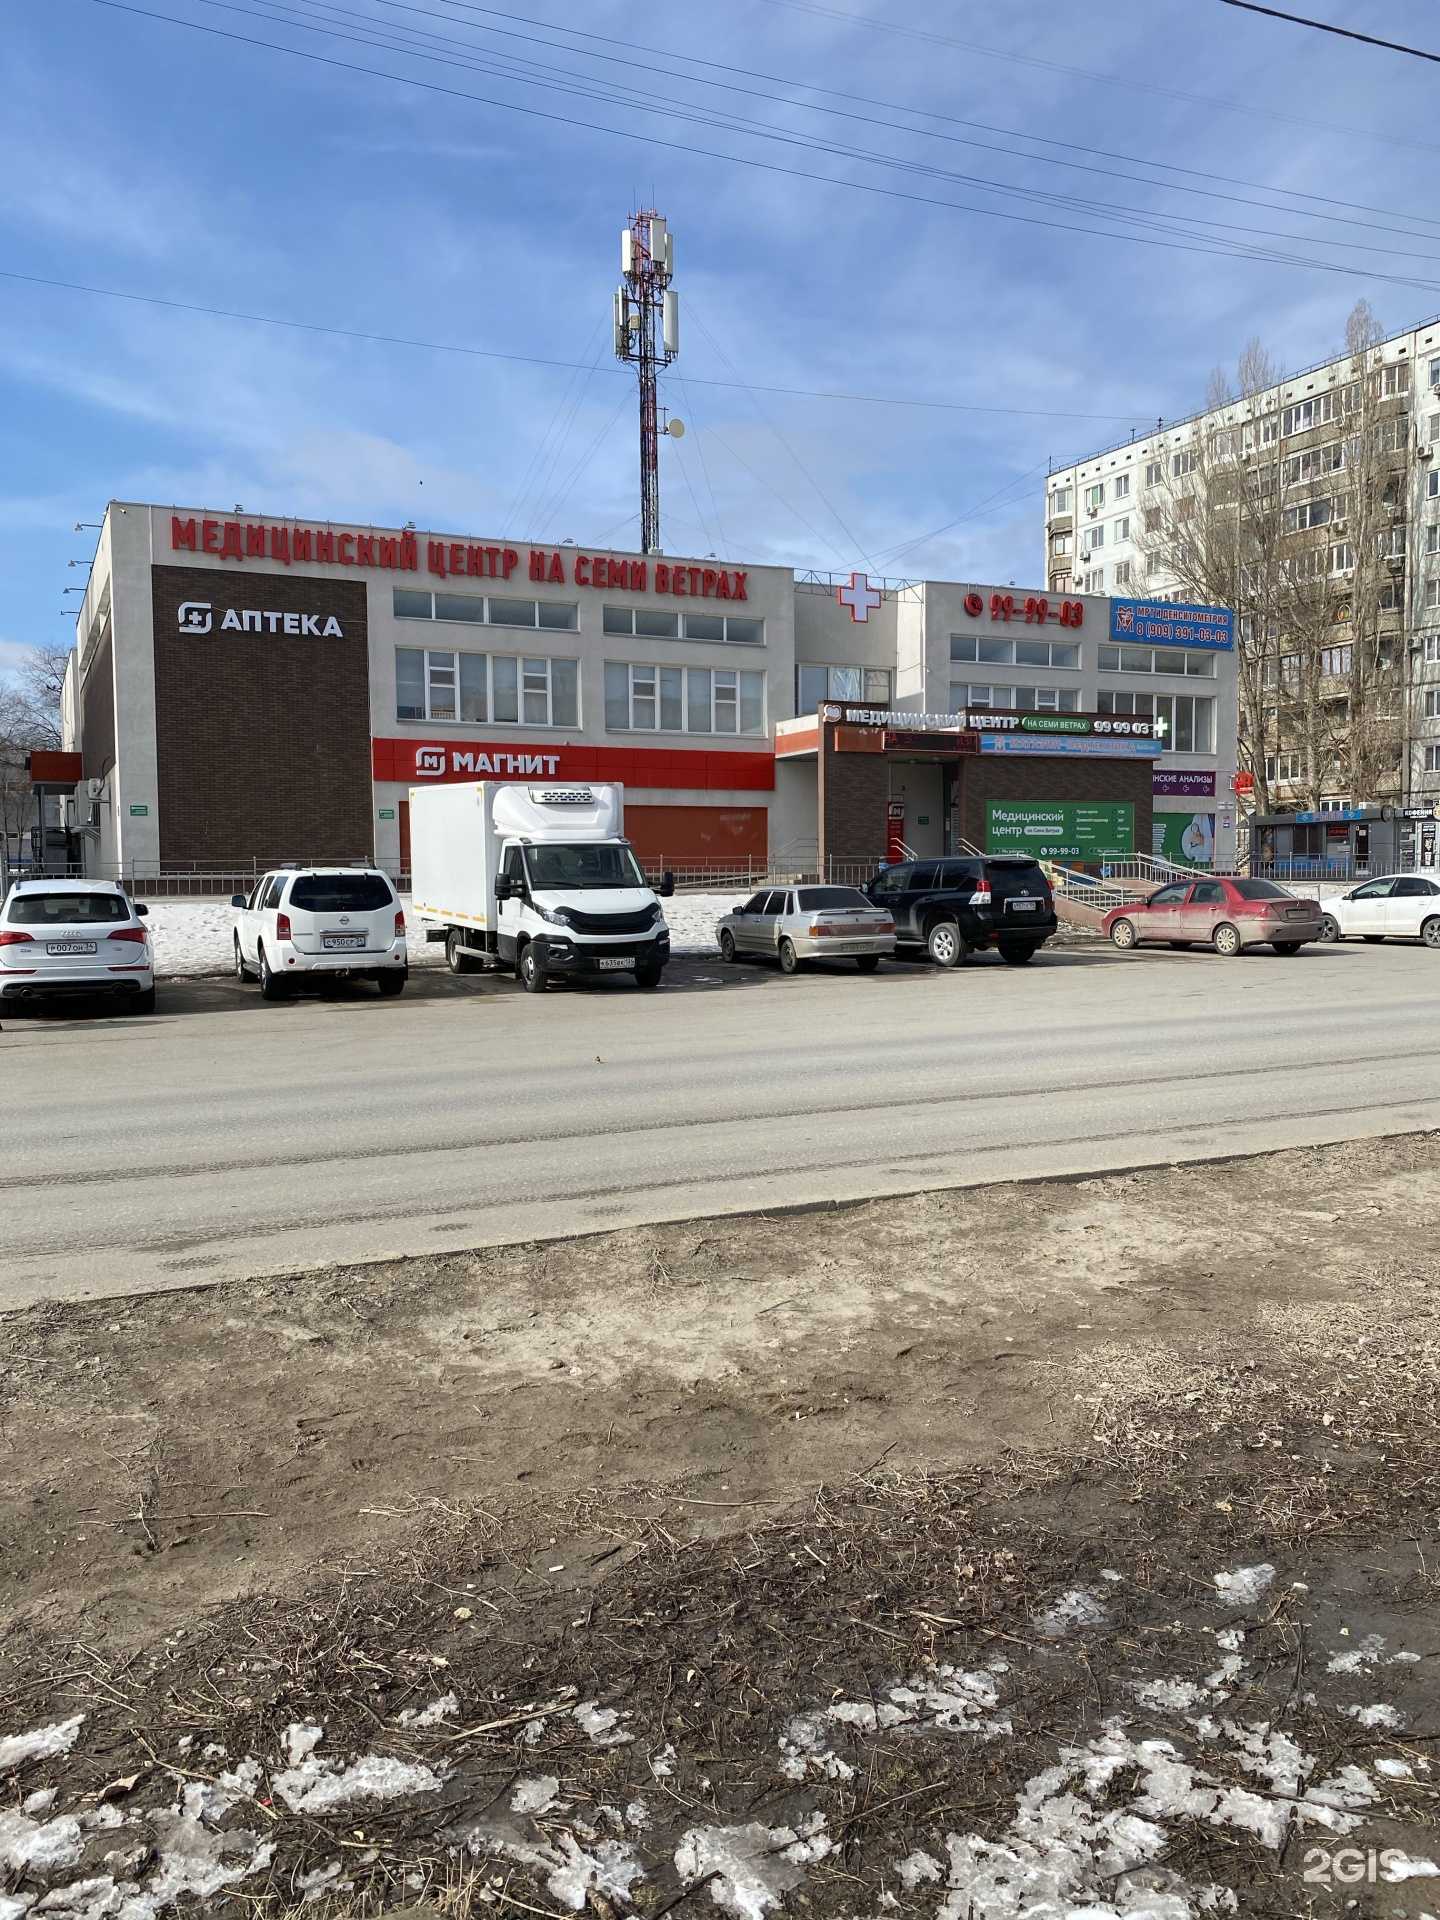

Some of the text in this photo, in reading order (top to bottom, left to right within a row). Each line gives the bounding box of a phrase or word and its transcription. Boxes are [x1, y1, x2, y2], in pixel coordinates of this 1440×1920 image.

[171, 517, 748, 600] МЕДИЦИНСКИЙ ЦЕНТР НА СЕМИ ВЕТРАХ
[991, 594, 1084, 628] 99-99-03
[220, 608, 343, 637] АПТЕКА
[1136, 621, 1229, 643] 8 (909) 391-03-03
[846, 709, 1019, 730] МЕДИЦИНСКИЙ ЦЕНТР
[1027, 720, 1086, 730] НА СЕМИ ВЕТРАХ
[453, 752, 560, 775] МАГНИТ
[1179, 775, 1213, 784] АНАЛИЗЫ
[992, 809, 1064, 822] Медицинский
[992, 827, 1022, 837] центр
[1049, 847, 1080, 855] 99-99-03
